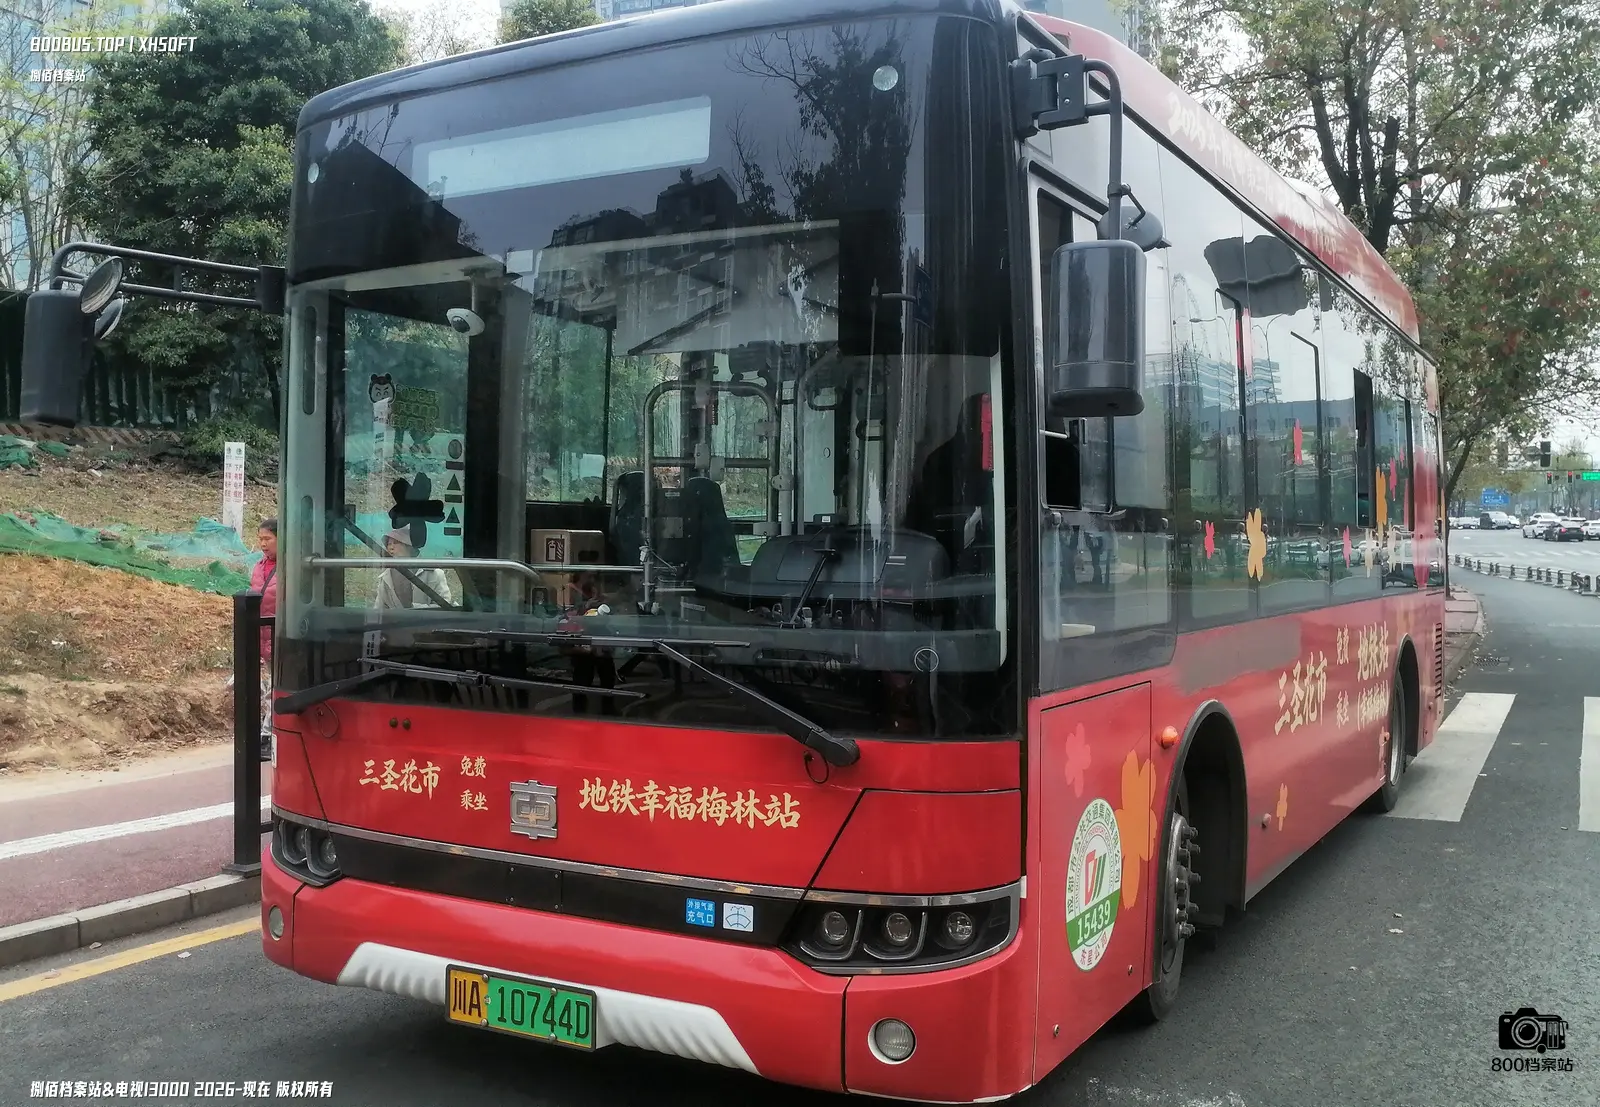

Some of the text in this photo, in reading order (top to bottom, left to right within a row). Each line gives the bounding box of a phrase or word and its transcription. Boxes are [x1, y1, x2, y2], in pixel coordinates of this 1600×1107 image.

[1274, 650, 1328, 736] 三圣花市
[359, 758, 441, 800] 三圣花市
[460, 755, 487, 779] 免费
[460, 789, 489, 811] 乘坐
[578, 776, 801, 829] 地铁幸福梅林站
[687, 910, 714, 924] 充气口
[1077, 899, 1111, 945] 15439
[452, 977, 590, 1039] 川A 10744D
